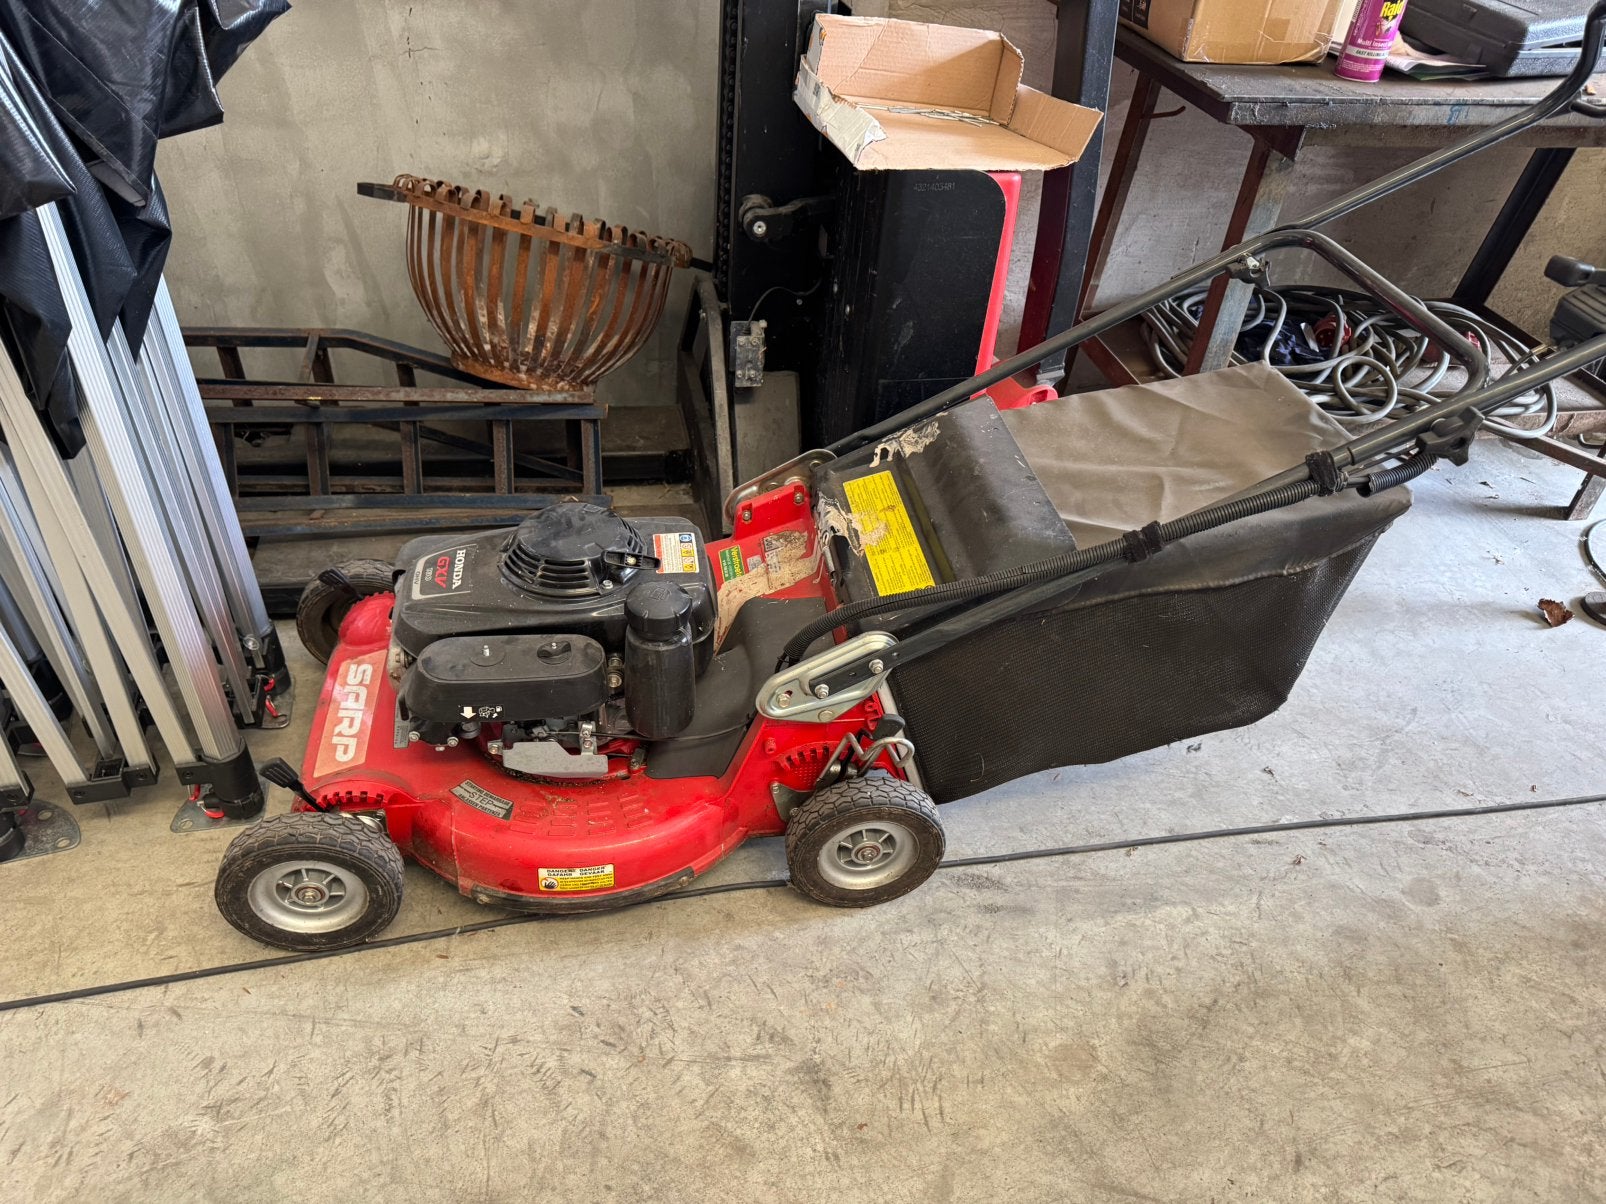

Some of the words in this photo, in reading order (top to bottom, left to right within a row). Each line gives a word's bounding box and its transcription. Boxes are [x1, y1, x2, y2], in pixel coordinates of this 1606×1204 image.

[1357, 38, 1373, 46] Multi
[435, 556, 450, 589] GXV
[452, 549, 466, 590] HONDA
[332, 663, 373, 762] SARP
[469, 791, 494, 806] STEP
